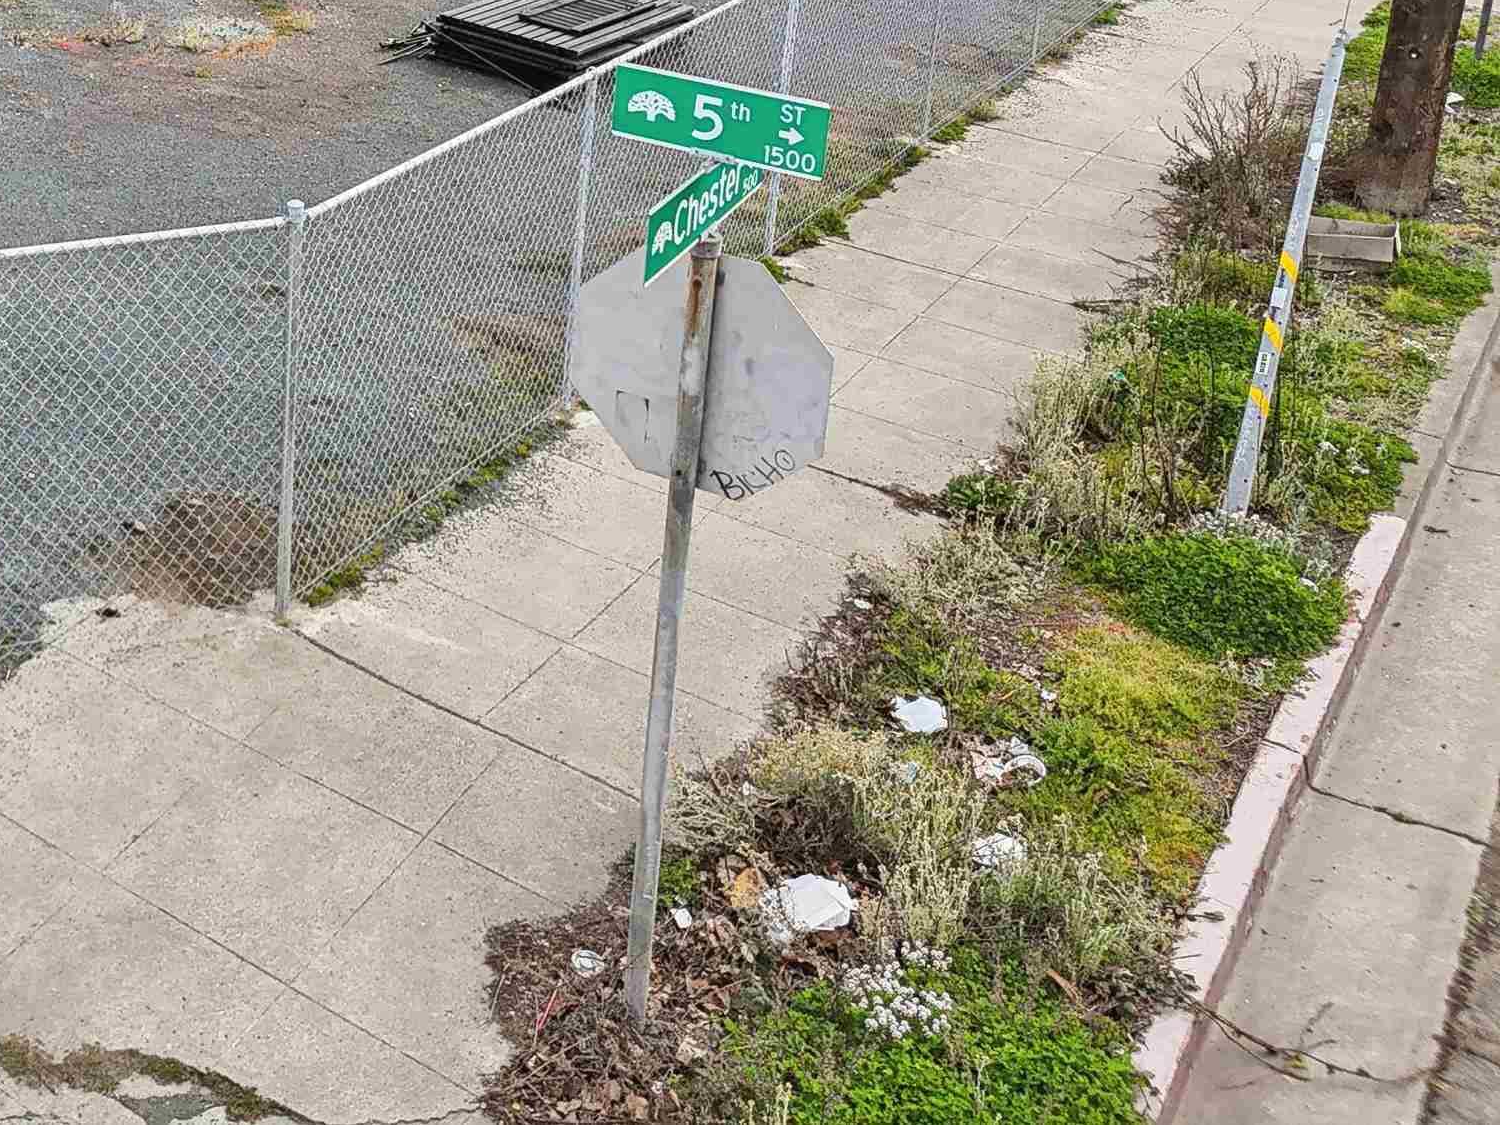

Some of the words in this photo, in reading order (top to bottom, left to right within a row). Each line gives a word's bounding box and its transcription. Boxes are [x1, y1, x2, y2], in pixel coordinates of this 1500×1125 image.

[691, 93, 751, 141] 5th
[779, 103, 806, 126] ST
[763, 144, 816, 173] 1500
[673, 162, 742, 246] Chester
[709, 449, 796, 501] BICHO
